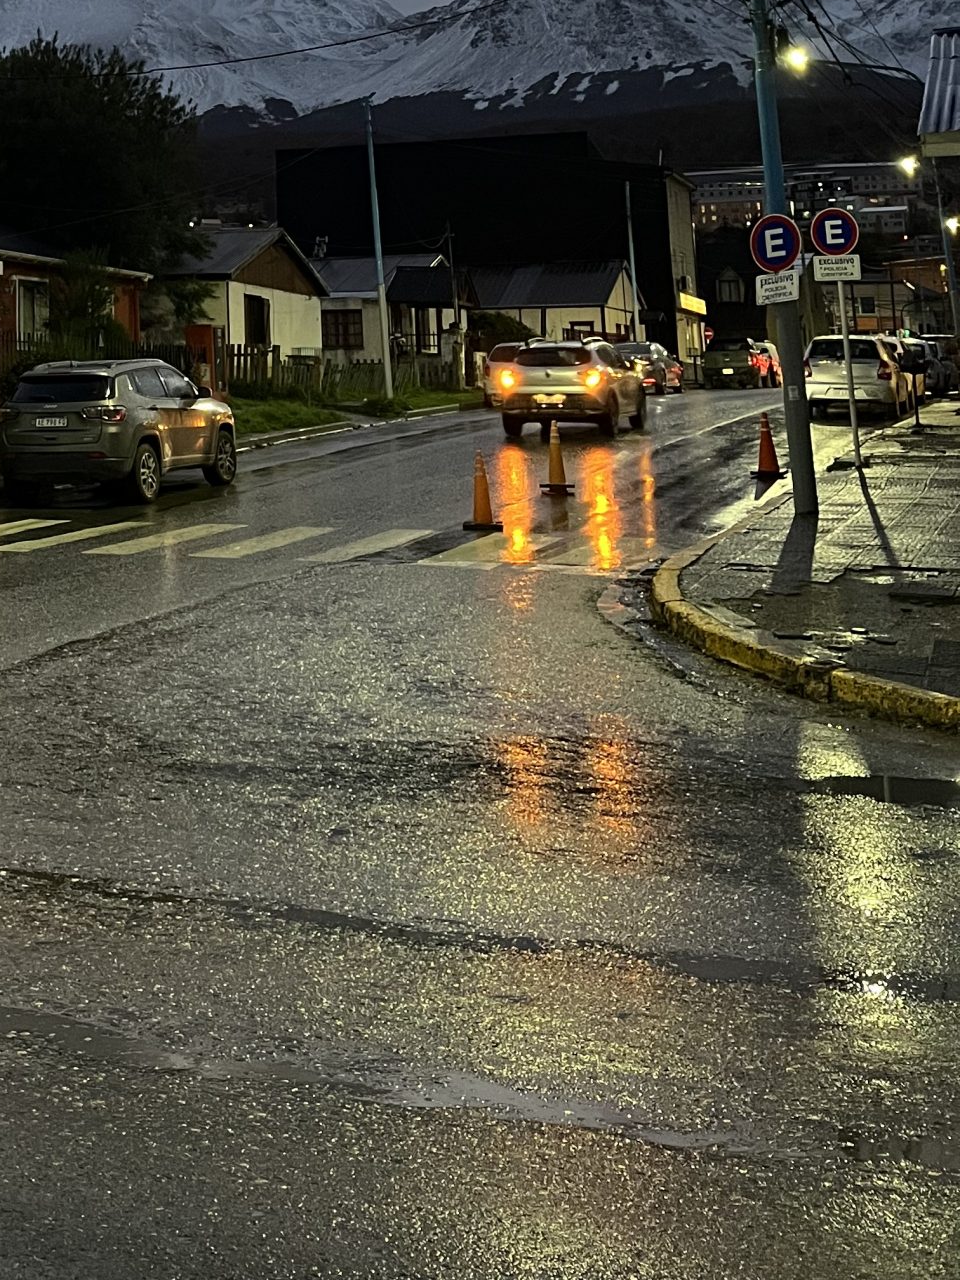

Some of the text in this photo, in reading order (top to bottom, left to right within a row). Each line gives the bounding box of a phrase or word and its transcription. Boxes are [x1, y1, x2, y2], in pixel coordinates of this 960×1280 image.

[824, 220, 845, 245] E
[764, 228, 787, 259] E
[818, 257, 855, 266] EXCLUSIVO
[760, 274, 794, 287] EXCLUSIVO
